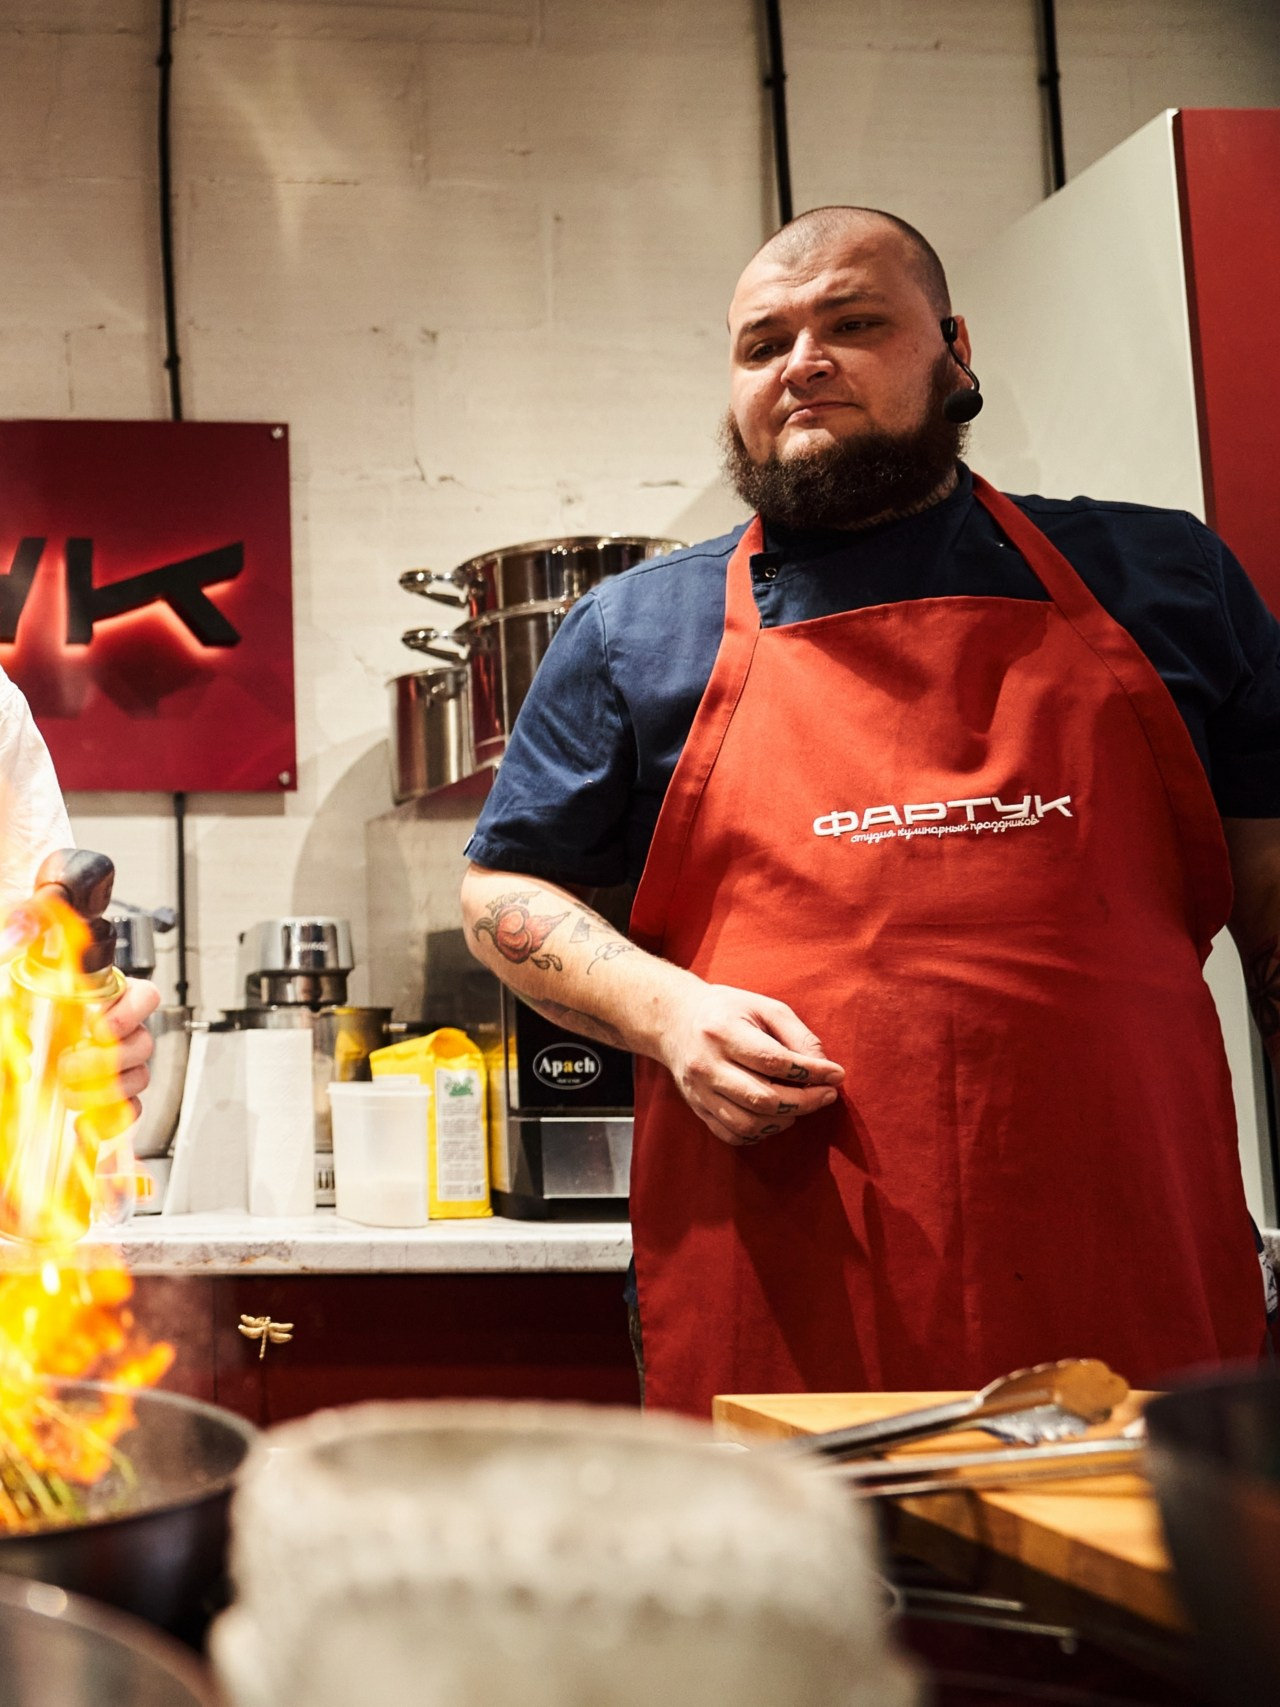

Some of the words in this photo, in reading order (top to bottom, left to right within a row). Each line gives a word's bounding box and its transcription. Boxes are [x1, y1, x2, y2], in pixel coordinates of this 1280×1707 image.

[813, 795, 1073, 837] ФАРТУК
[851, 829, 896, 844] студия
[539, 1056, 596, 1078] Apach
